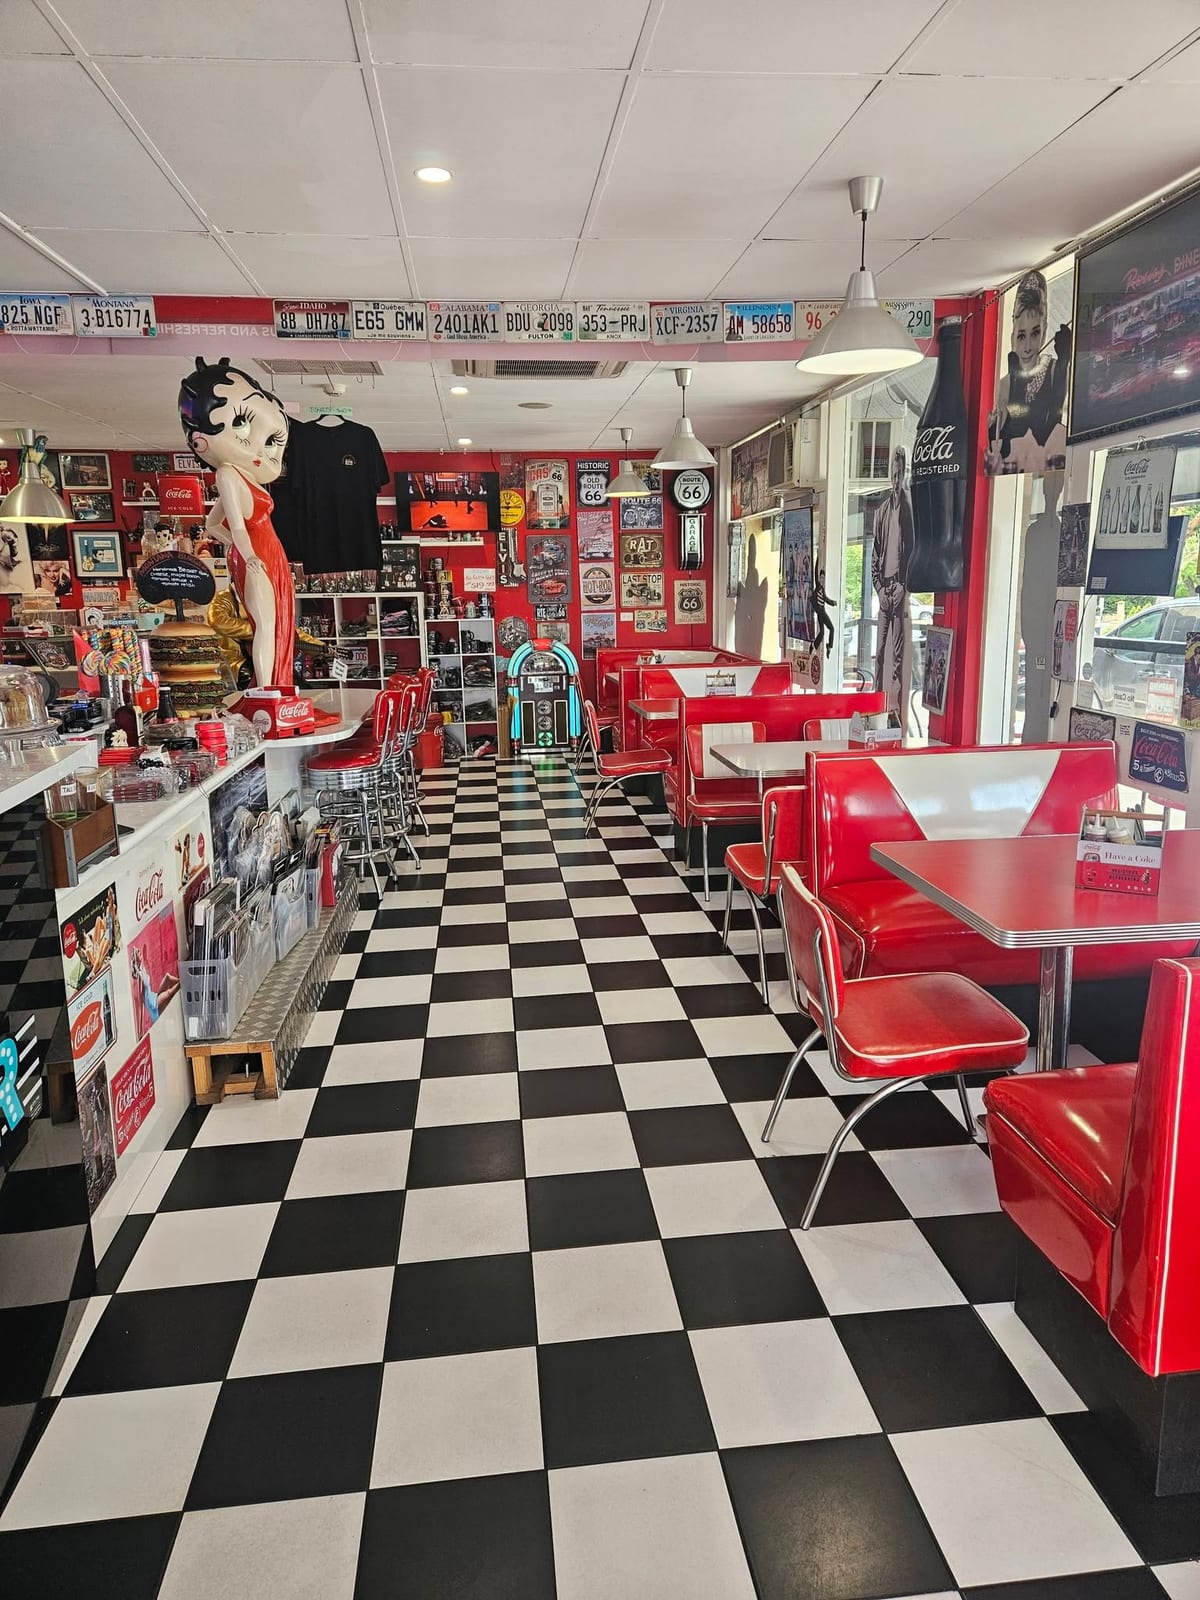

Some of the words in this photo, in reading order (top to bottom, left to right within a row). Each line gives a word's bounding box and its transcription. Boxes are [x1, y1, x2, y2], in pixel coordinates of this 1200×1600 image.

[1174, 247, 1200, 274] DINE
[91, 299, 135, 309] MONTANA
[300, 302, 327, 310] IDAHO
[445, 303, 485, 312] ALABAMA
[520, 303, 560, 311] GEORGIA
[669, 305, 704, 315] VIRGINIA
[1, 305, 28, 324] 825
[34, 306, 62, 325] NGF
[306, 312, 346, 330] DH787
[355, 311, 385, 331] E65
[395, 311, 424, 332] GMW
[434, 313, 499, 334] 2401AK1
[506, 313, 531, 331] BDU
[541, 312, 574, 332] 2098
[751, 313, 792, 334] 58658
[805, 311, 822, 330] 96
[907, 310, 932, 328] 290
[656, 314, 719, 336] XCF-2357
[913, 425, 956, 463] Cola
[577, 462, 610, 470] HISTORIC
[165, 488, 193, 499] Coca-Cola
[584, 490, 602, 502] 66
[621, 497, 651, 505] ROUTE
[651, 497, 662, 505] 66
[682, 485, 702, 500] 66
[629, 537, 654, 553] RAT
[498, 532, 508, 584] ELVIS
[622, 575, 641, 585] LAST
[642, 574, 662, 584] STOP
[683, 598, 698, 609] 66
[278, 701, 310, 720] Coca-Cola
[1133, 736, 1179, 769] Coca-Cola
[1132, 759, 1140, 771] 5
[1105, 851, 1126, 861] Have
[1134, 854, 1156, 864] Coke
[135, 867, 164, 922] Coca-Cola
[75, 1007, 100, 1050] Coca-Cola
[115, 1053, 151, 1124] Coca-Cola
